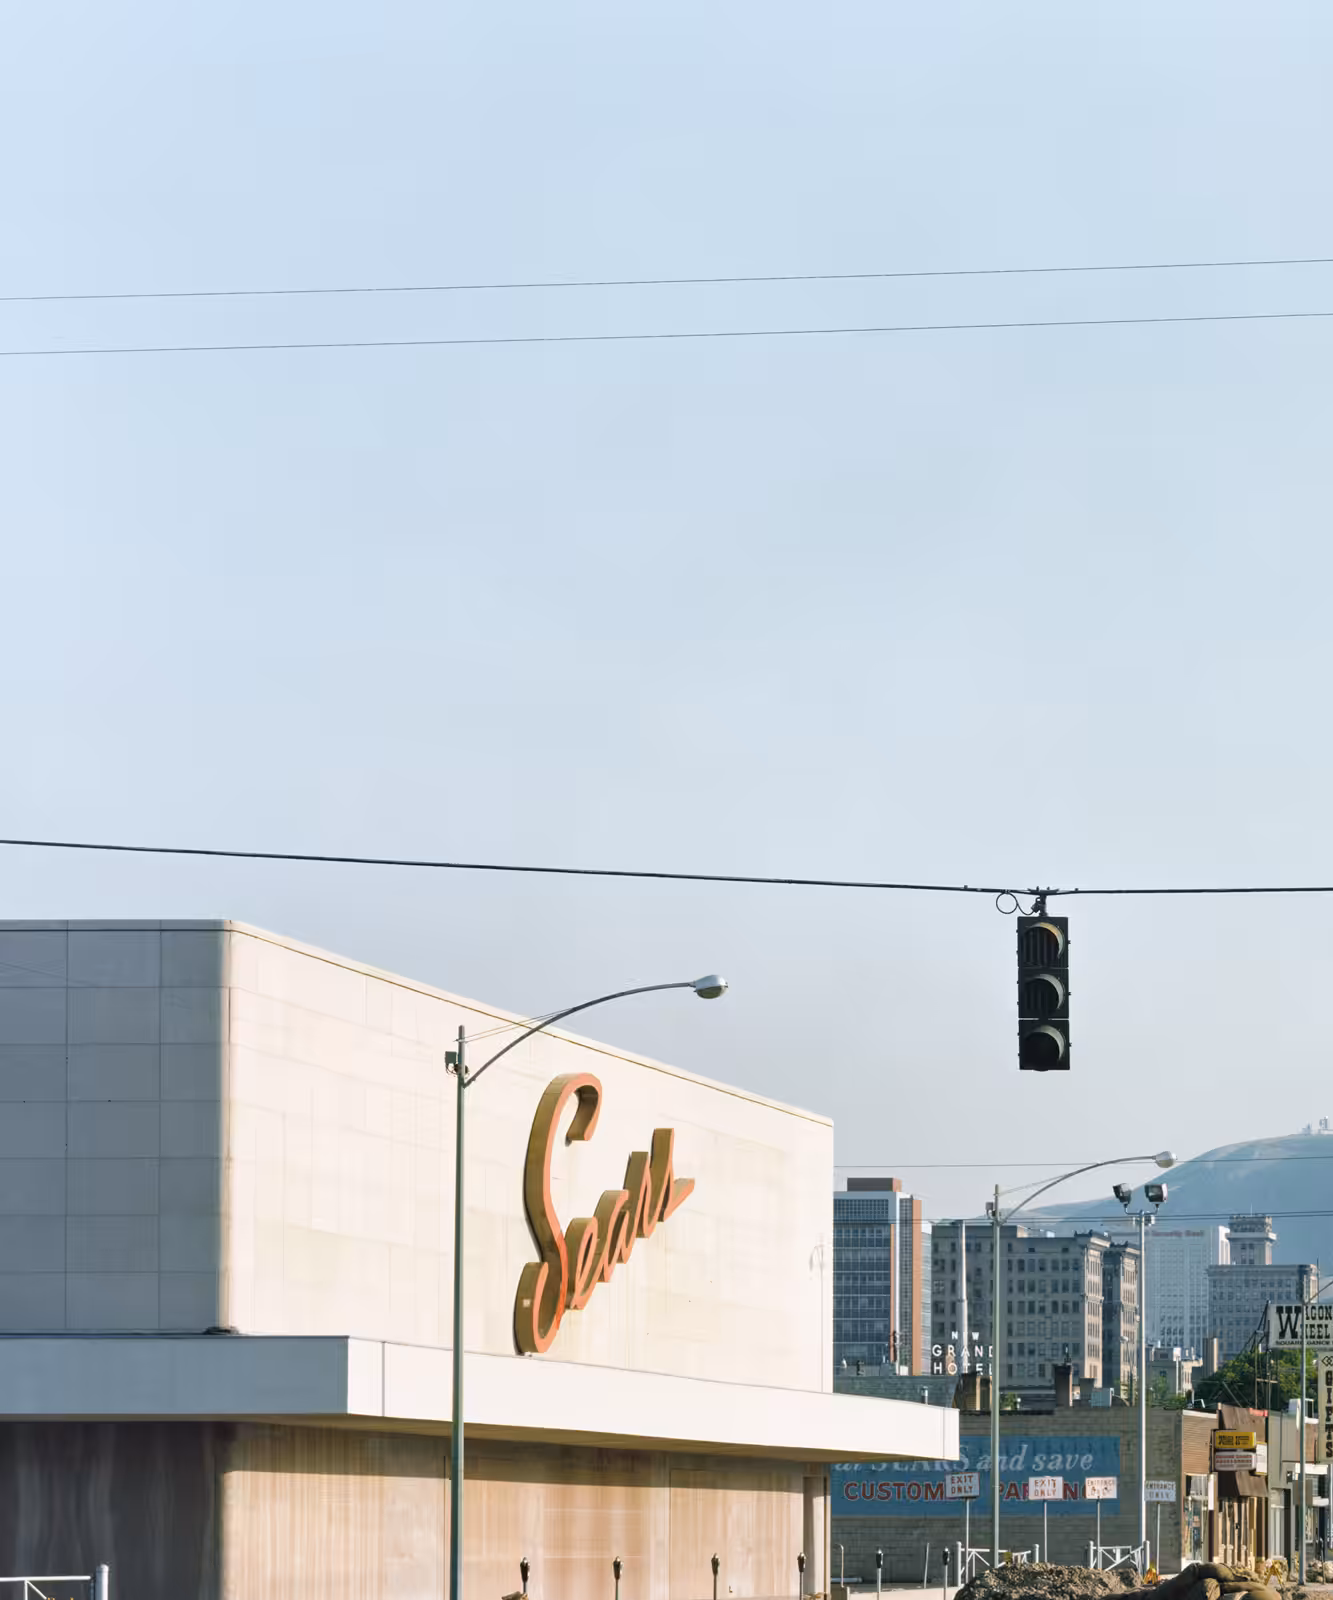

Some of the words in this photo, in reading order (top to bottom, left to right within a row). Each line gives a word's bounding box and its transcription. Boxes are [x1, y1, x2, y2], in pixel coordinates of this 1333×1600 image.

[513, 1072, 695, 1354] Sears
[951, 1332, 979, 1340] NW
[1032, 1452, 1094, 1471] save
[951, 1475, 973, 1484] EXIT
[1034, 1479, 1056, 1488] EXIT
[844, 1482, 946, 1501] CUSTOM
